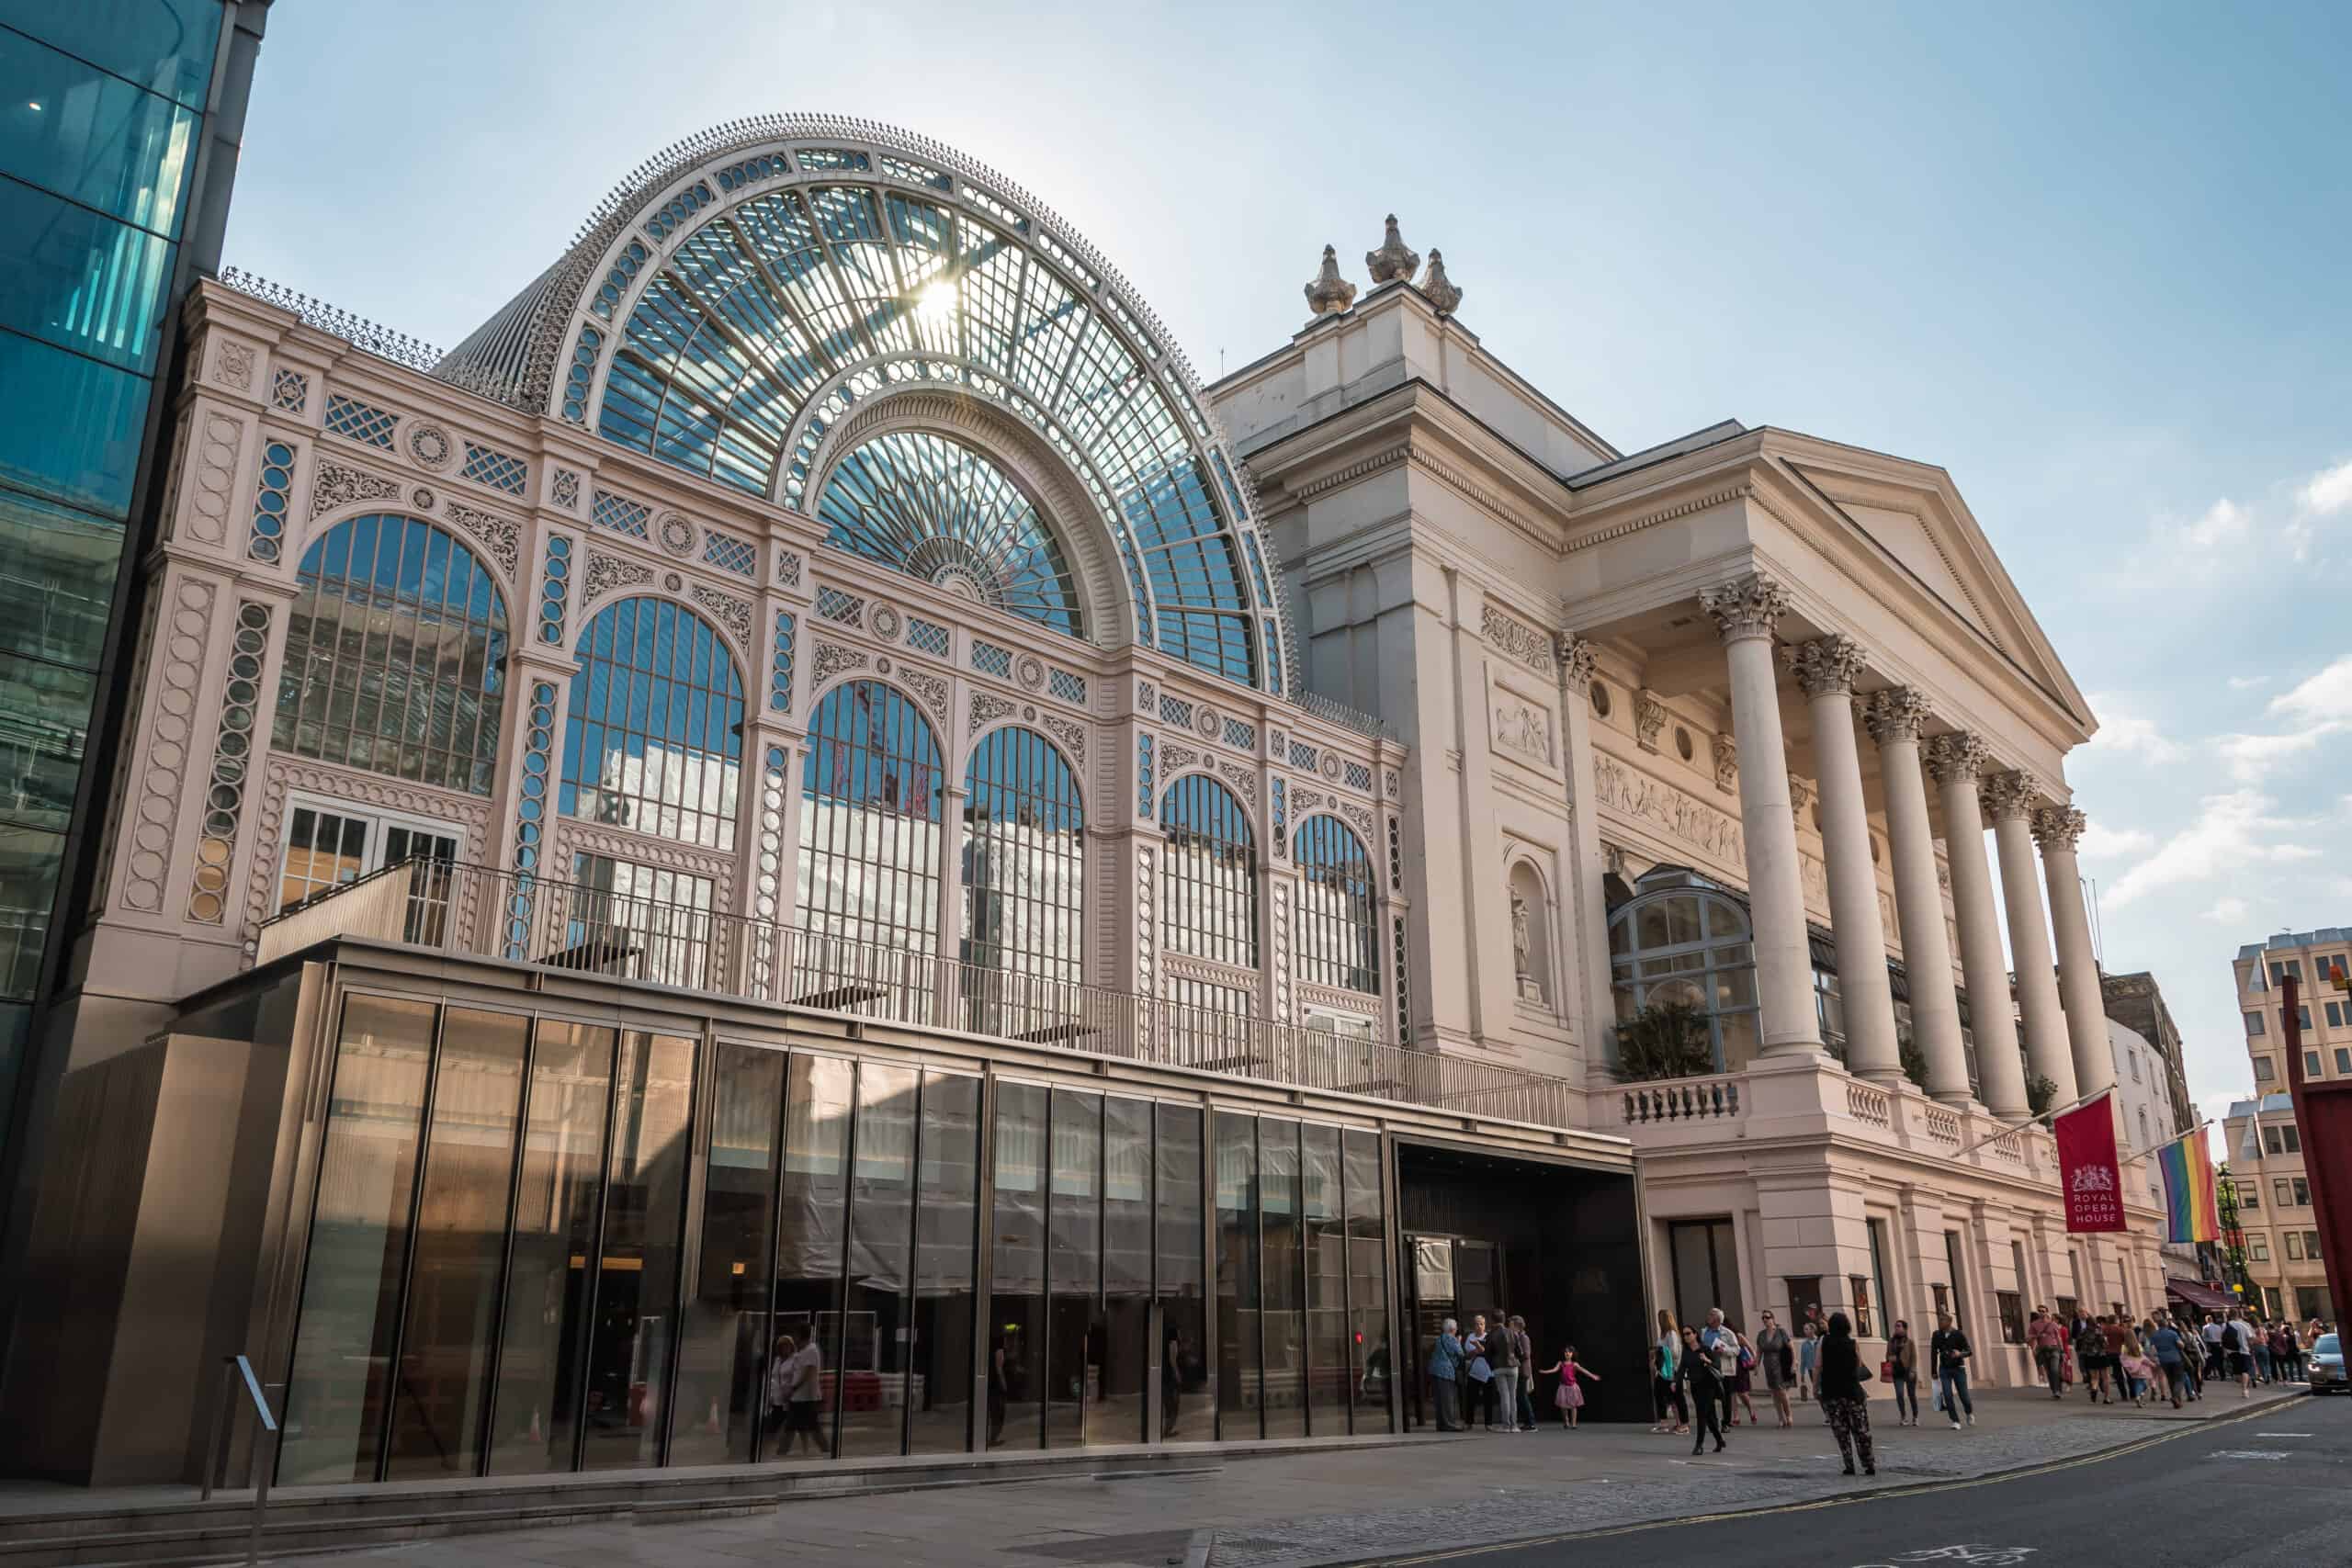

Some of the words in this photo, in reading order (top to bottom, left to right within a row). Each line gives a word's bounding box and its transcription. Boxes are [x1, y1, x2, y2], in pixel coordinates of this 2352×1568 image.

[2074, 1193, 2114, 1202] ROYAL
[2075, 1203, 2116, 1213] OPERA
[2076, 1213, 2117, 1223] HOUSE
